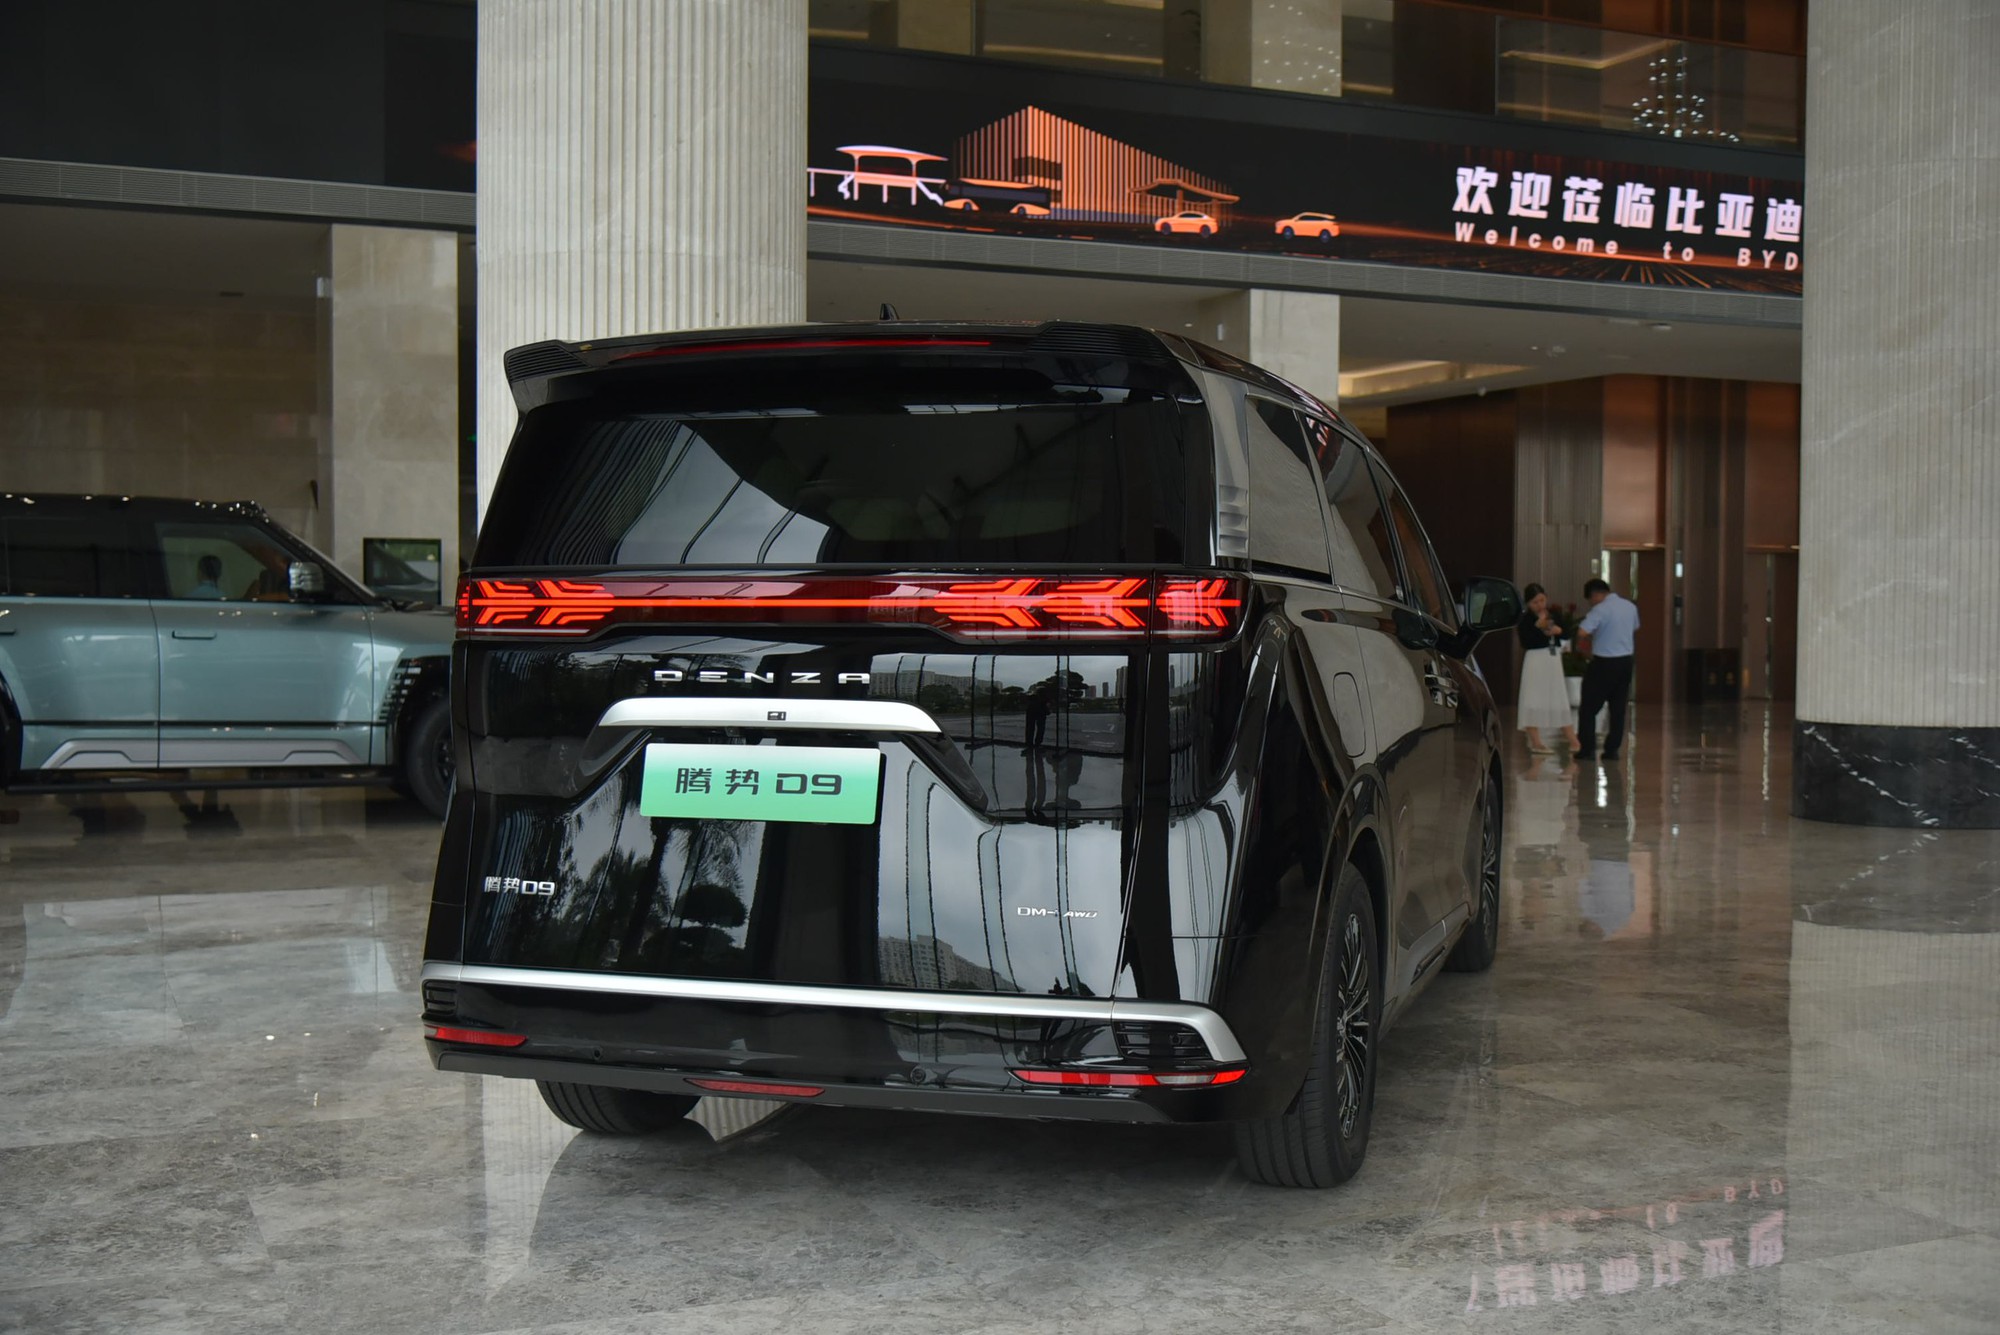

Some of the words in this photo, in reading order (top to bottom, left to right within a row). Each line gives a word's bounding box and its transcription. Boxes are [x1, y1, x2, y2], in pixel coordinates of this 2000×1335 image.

[1452, 166, 1802, 242] 欢迎莅临比亚迪
[1454, 221, 1619, 255] Welcome
[1662, 241, 1695, 262] to
[1736, 247, 1799, 271] BYD
[654, 670, 871, 684] DENZA
